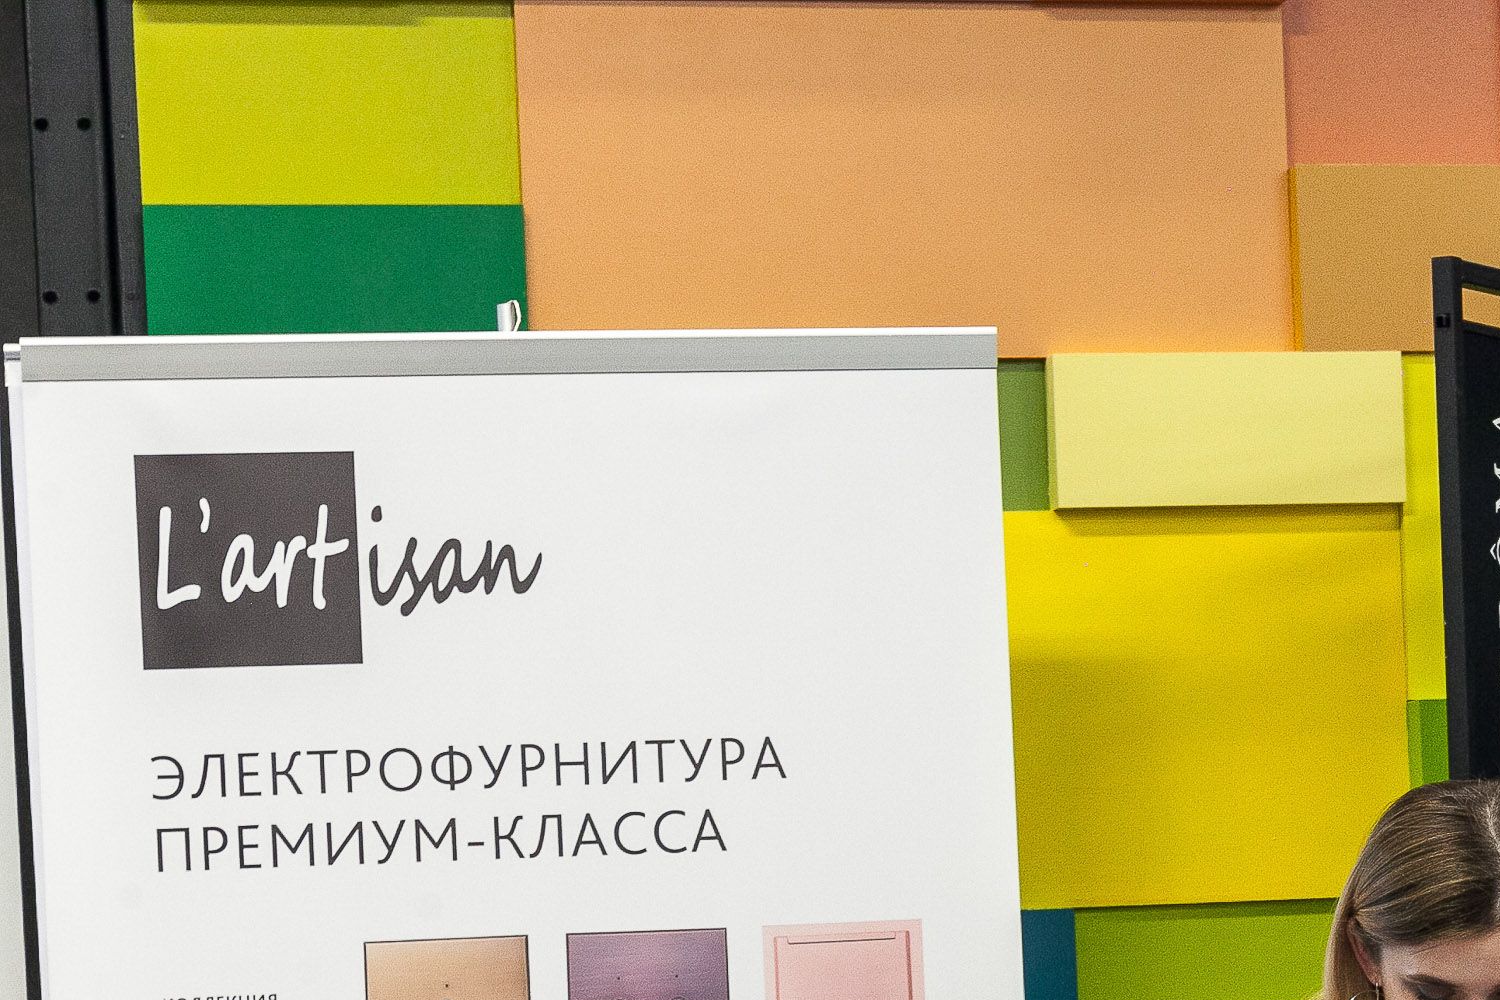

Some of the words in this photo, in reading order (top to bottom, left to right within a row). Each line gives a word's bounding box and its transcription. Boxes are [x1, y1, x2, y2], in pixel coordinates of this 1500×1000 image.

[155, 497, 543, 617] L'artisan
[150, 736, 787, 801] ЭЛЕКТРОФУРНИТУРА
[156, 808, 728, 873] ПРЕМИУМ-КЛАССА
